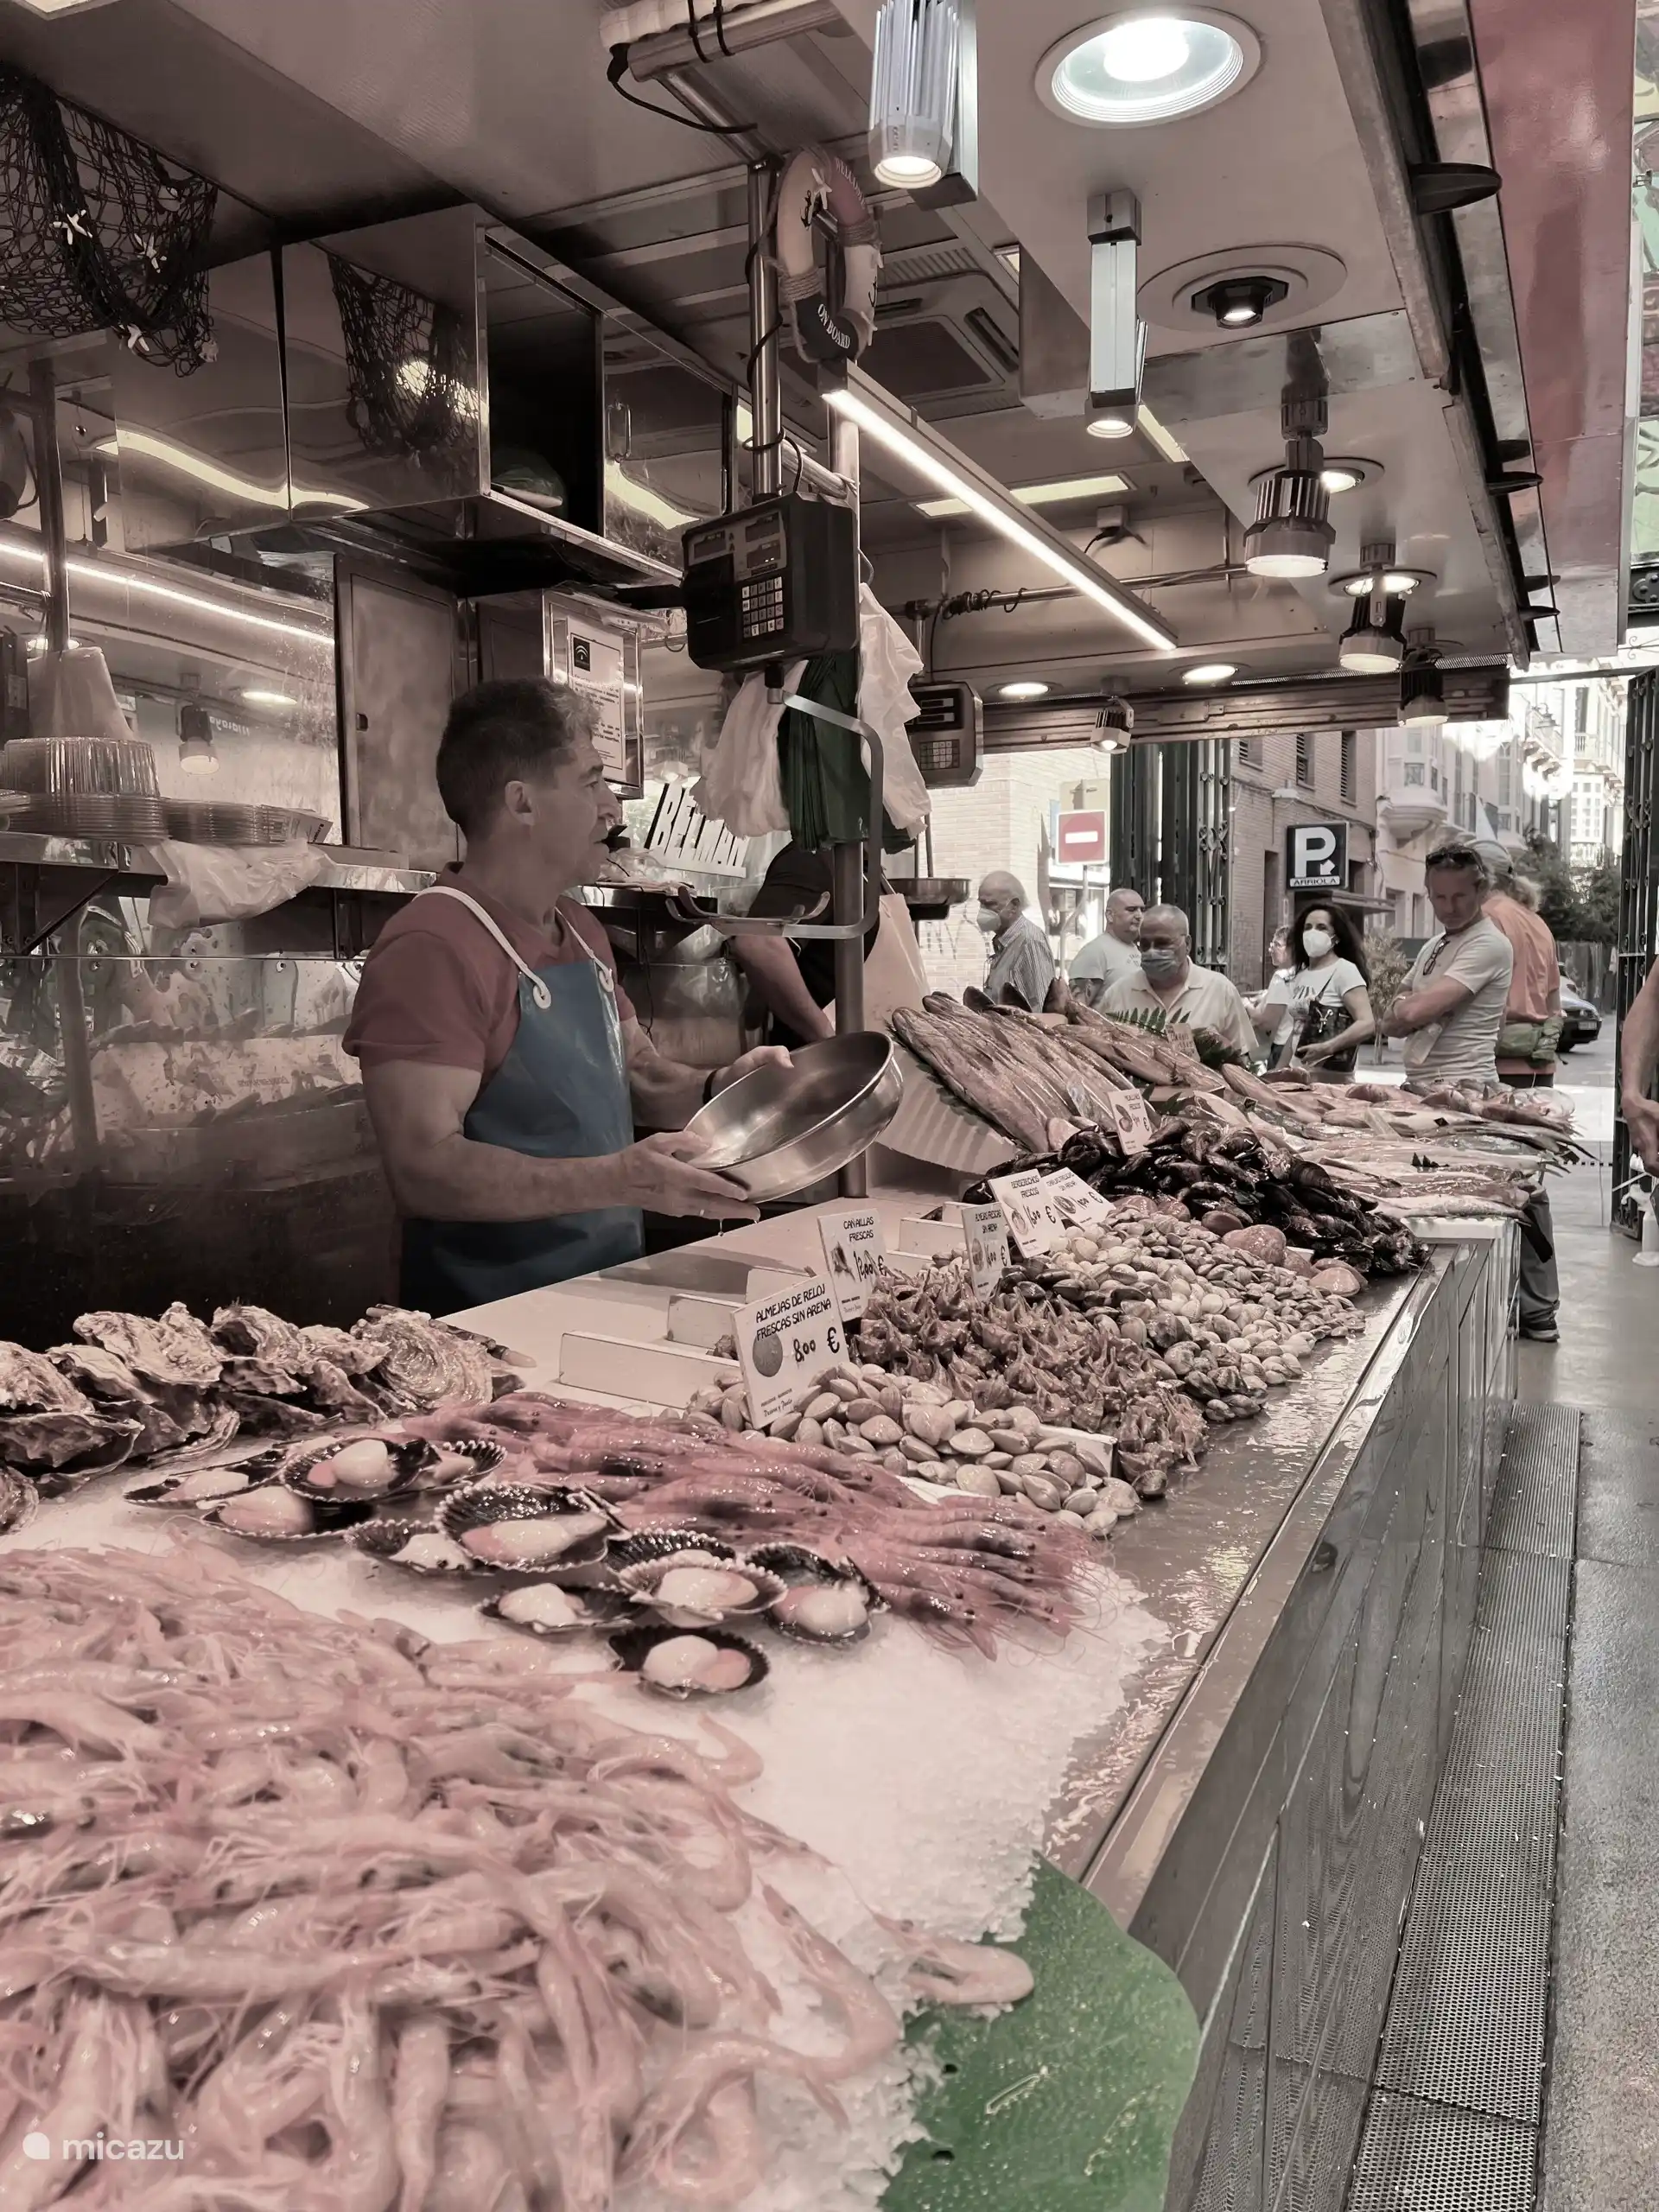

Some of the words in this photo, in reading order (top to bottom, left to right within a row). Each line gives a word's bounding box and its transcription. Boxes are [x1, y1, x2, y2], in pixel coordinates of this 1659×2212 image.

[817, 303, 830, 327] ON
[826, 319, 851, 349] BOARD
[1294, 826, 1337, 878] P
[1294, 877, 1337, 886] ARRIOLA
[1045, 1205, 1057, 1224] €
[849, 1230, 874, 1243] FRESCAS
[756, 1298, 791, 1323] ALMEJAS
[791, 1294, 803, 1307] DE
[804, 1283, 825, 1302] RELOJ
[756, 1315, 792, 1341] FRESCAS
[792, 1309, 805, 1325] SIN
[806, 1298, 831, 1319] ARENA
[826, 1326, 841, 1354] €
